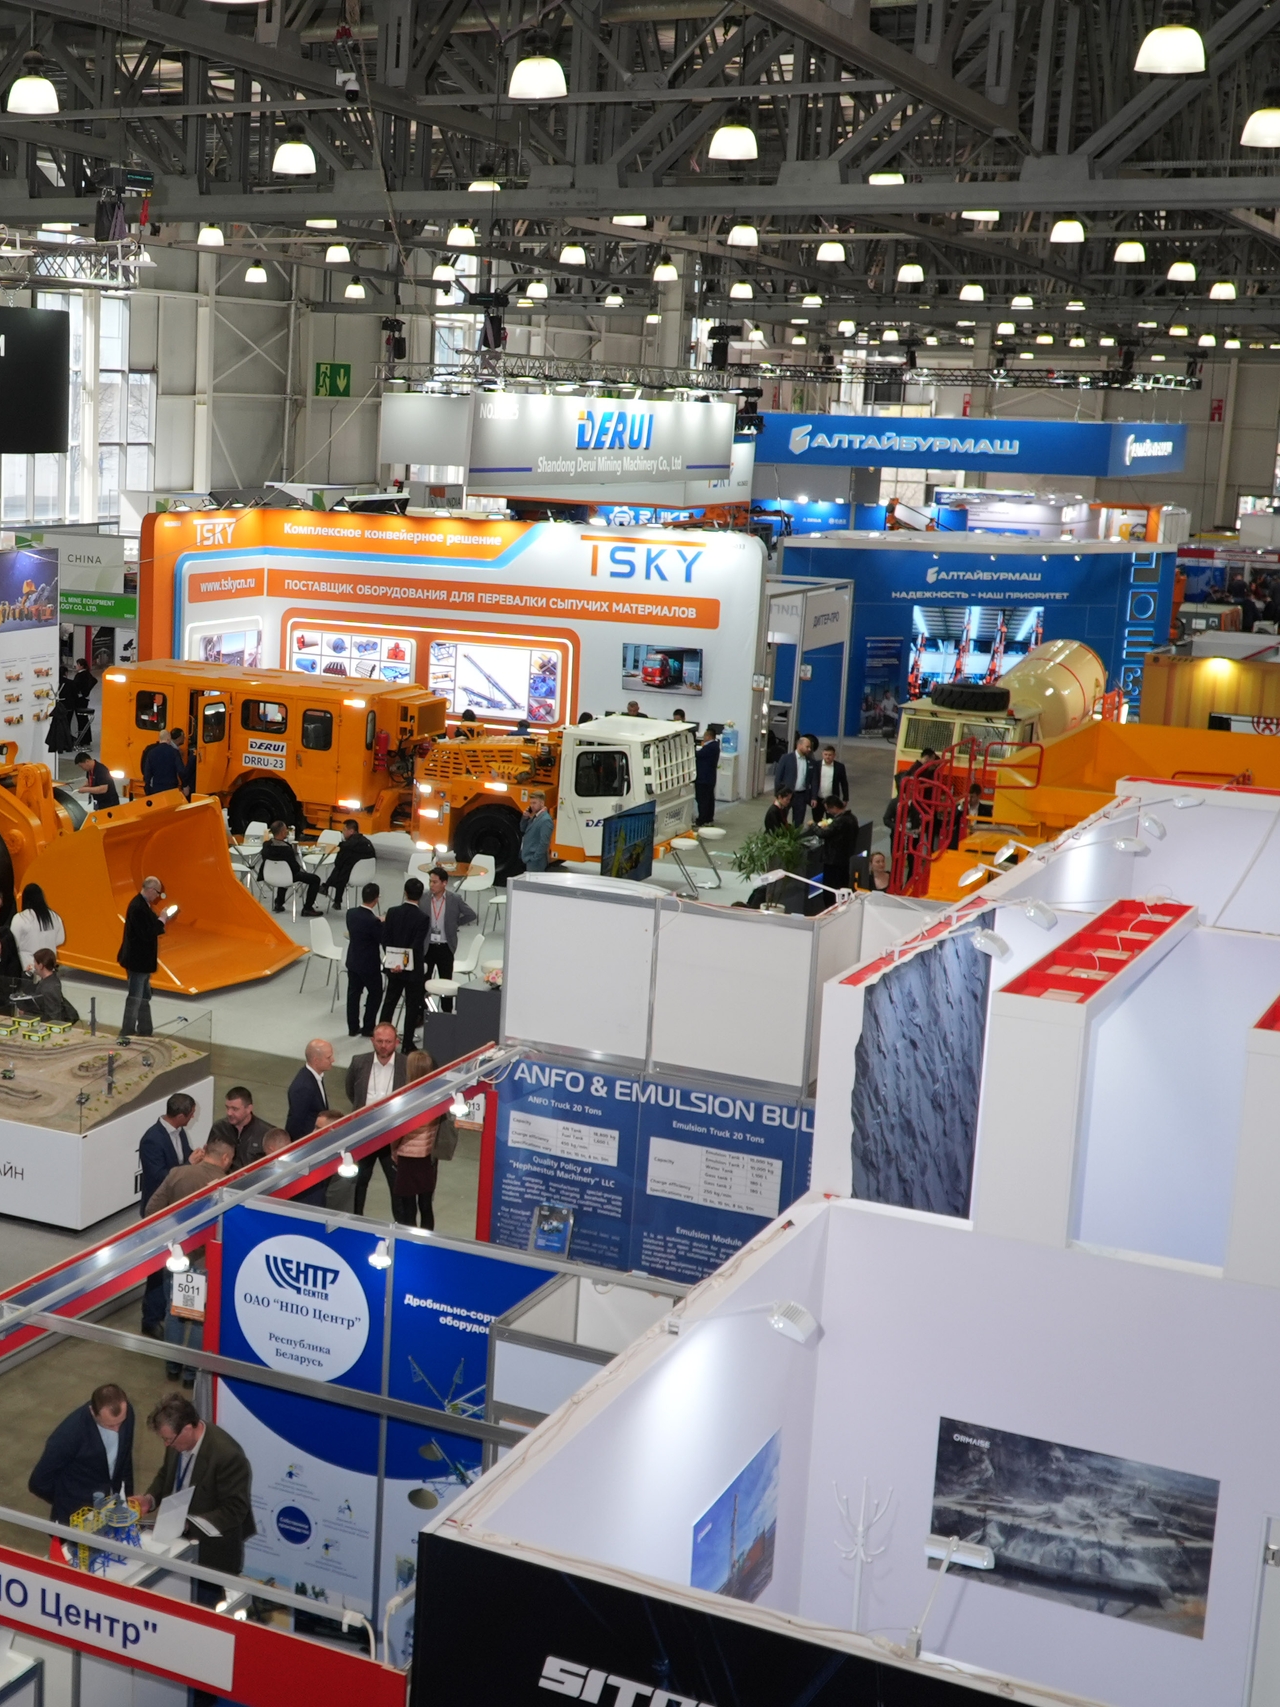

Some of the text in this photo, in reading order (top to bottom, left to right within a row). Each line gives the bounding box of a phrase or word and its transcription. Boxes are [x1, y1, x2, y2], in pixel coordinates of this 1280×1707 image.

[576, 410, 654, 450] DERUI
[811, 432, 1019, 455] АЛТАЙБУРМАШ
[537, 456, 574, 476] Shandong
[577, 457, 596, 472] Derui
[598, 457, 621, 475] Mining
[623, 456, 658, 475] Machinery
[671, 455, 682, 471] Ltd
[193, 518, 236, 546] TSKY
[284, 523, 502, 546] Комплексное конвейерное решение
[67, 554, 102, 564] CHINA
[580, 534, 706, 583] TSKY
[200, 576, 255, 593] www.tskycn.ru
[938, 570, 1041, 581] АЛТАЙБУРМАШ
[83, 598, 115, 606] EQUIPMENT
[285, 579, 697, 619] ПОСТАВЩИК ОБОРУДОВАНИЯ ДЛЯ ПЕРЕВАЛКИ СЫПУЧИХ МАТЕРИАЛОВ
[892, 591, 969, 599] НАДЕЖНОСТЬ
[1006, 592, 1069, 600] ПРИОРИТЕТ
[250, 741, 285, 752] DERUI
[244, 755, 284, 769] DRRU-23
[514, 1062, 585, 1093] ANFO
[590, 1076, 607, 1098] &
[615, 1080, 755, 1122] EMULSION
[528, 1095, 602, 1116] ANFO Truck 20 Tons
[672, 1120, 765, 1144] Emulsion Truck 20 Tons
[533, 1155, 558, 1168] Quality
[560, 1160, 581, 1173] Policy
[584, 1166, 592, 1174] of
[601, 1178, 615, 1188] LLC
[676, 1226, 743, 1246] Emulsion Module
[186, 1274, 193, 1283] D
[178, 1283, 200, 1296] 5011
[303, 1288, 329, 1301] CENTER
[244, 1292, 270, 1308] ОАО
[269, 1332, 331, 1355] Республика
[275, 1348, 323, 1367] Беларусь
[953, 1433, 991, 1449] ORMAISE
[40, 1588, 158, 1649] Центр"
